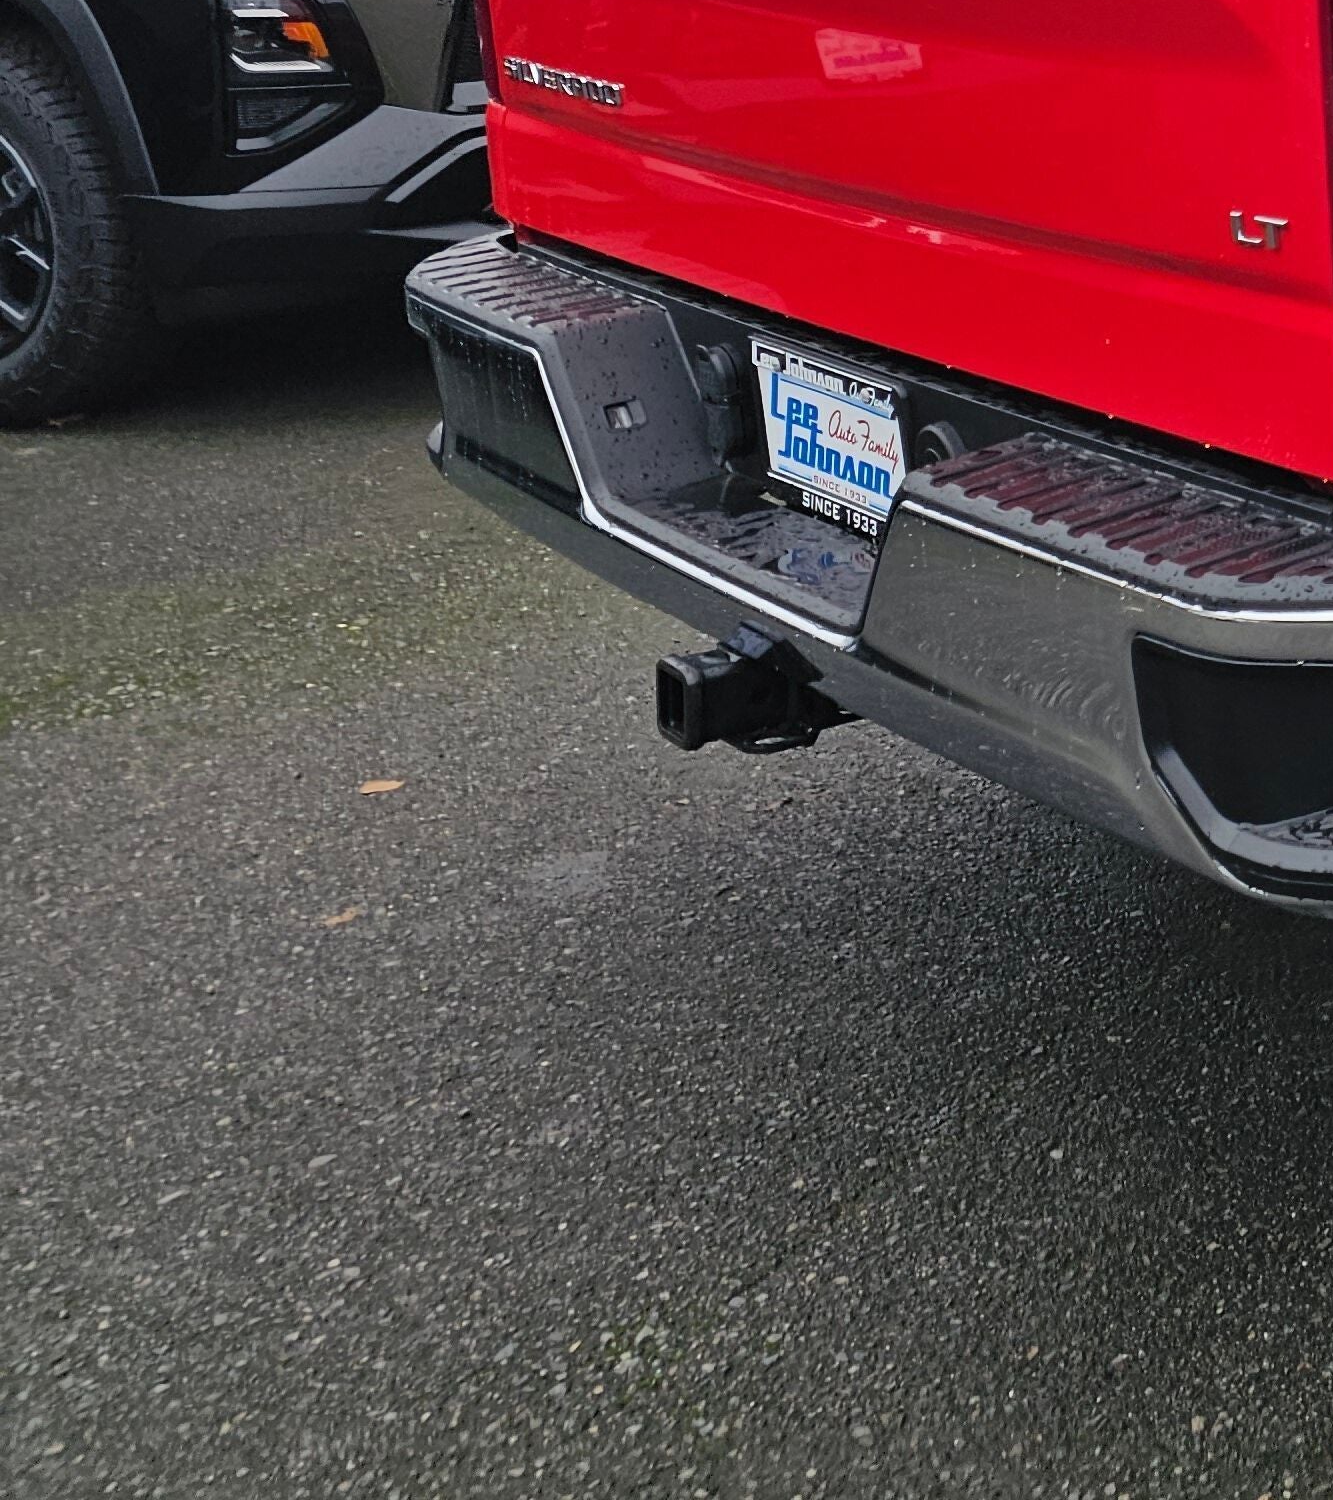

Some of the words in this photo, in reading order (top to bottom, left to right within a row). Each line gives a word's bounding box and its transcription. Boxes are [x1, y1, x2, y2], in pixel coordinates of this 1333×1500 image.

[1229, 210, 1289, 250] LT
[771, 373, 823, 435] Lee
[778, 424, 894, 499] Johnson
[828, 409, 858, 446] Auto
[857, 419, 900, 475] Family
[802, 491, 841, 522] SINCE
[846, 509, 878, 538] 1933
[813, 475, 841, 493] SINCE
[844, 488, 868, 505] 1933
